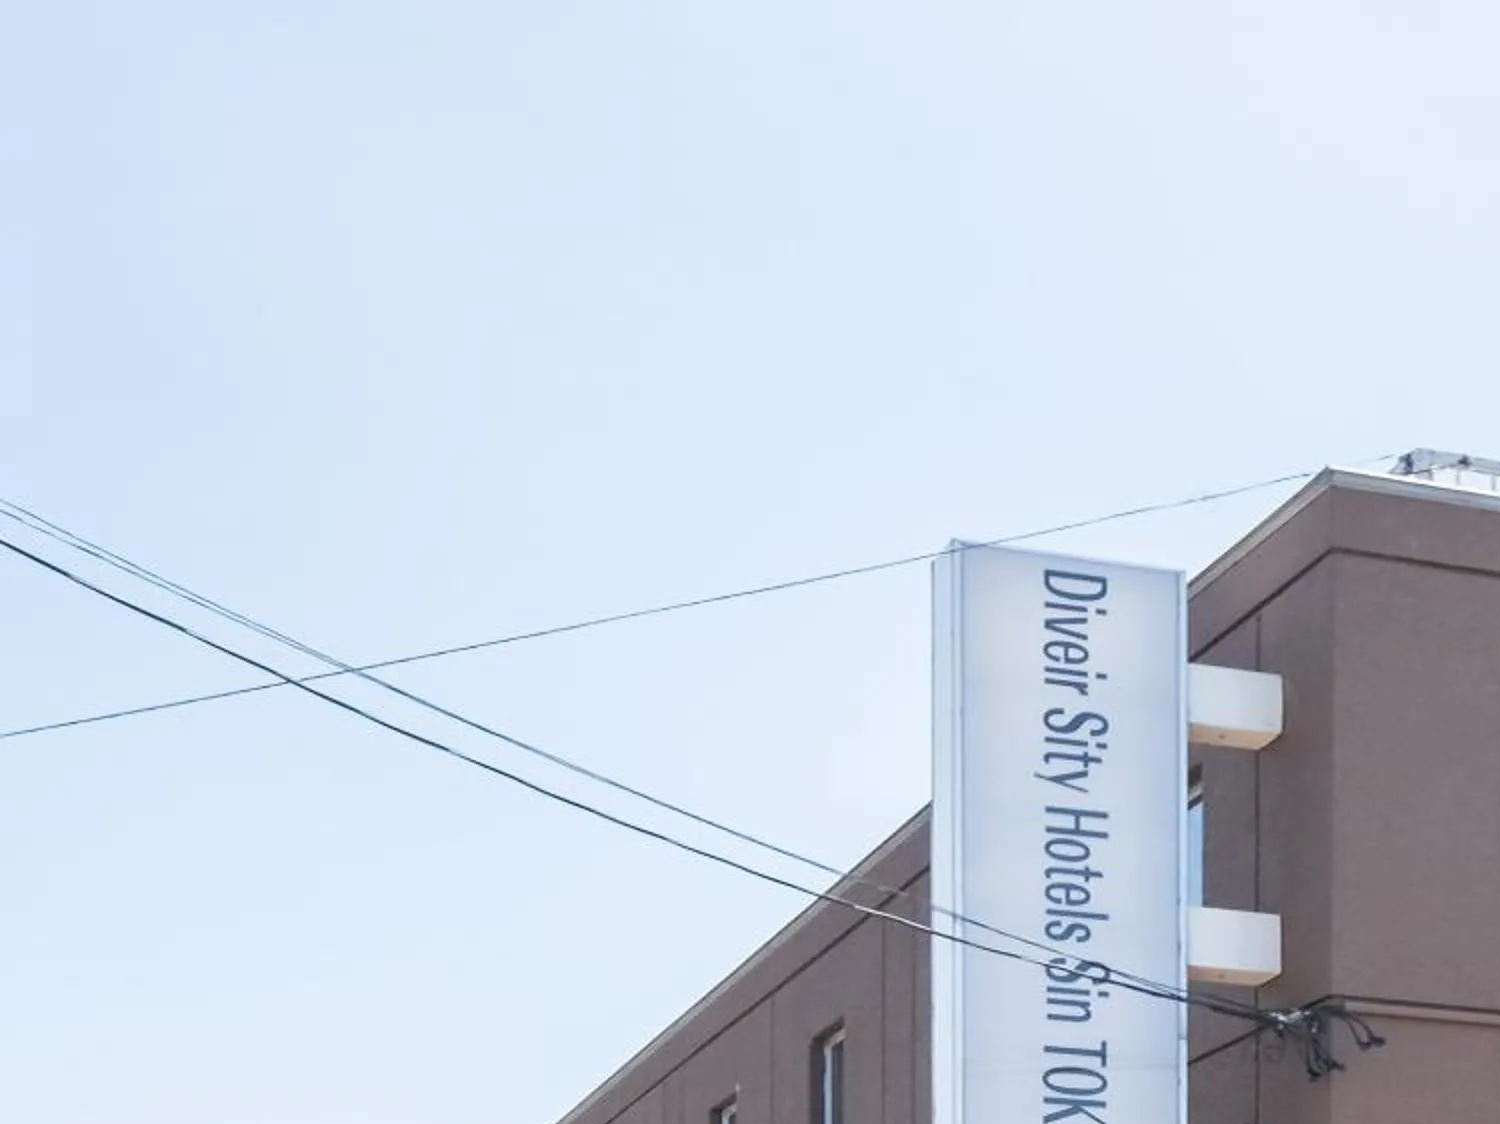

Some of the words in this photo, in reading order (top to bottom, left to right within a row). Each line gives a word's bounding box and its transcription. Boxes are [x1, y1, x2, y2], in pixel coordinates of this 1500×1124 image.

[1043, 569, 1108, 696] Diveir
[1034, 707, 1109, 793] Sity
[1044, 806, 1110, 943] Hotels
[1045, 957, 1110, 1023] Sin
